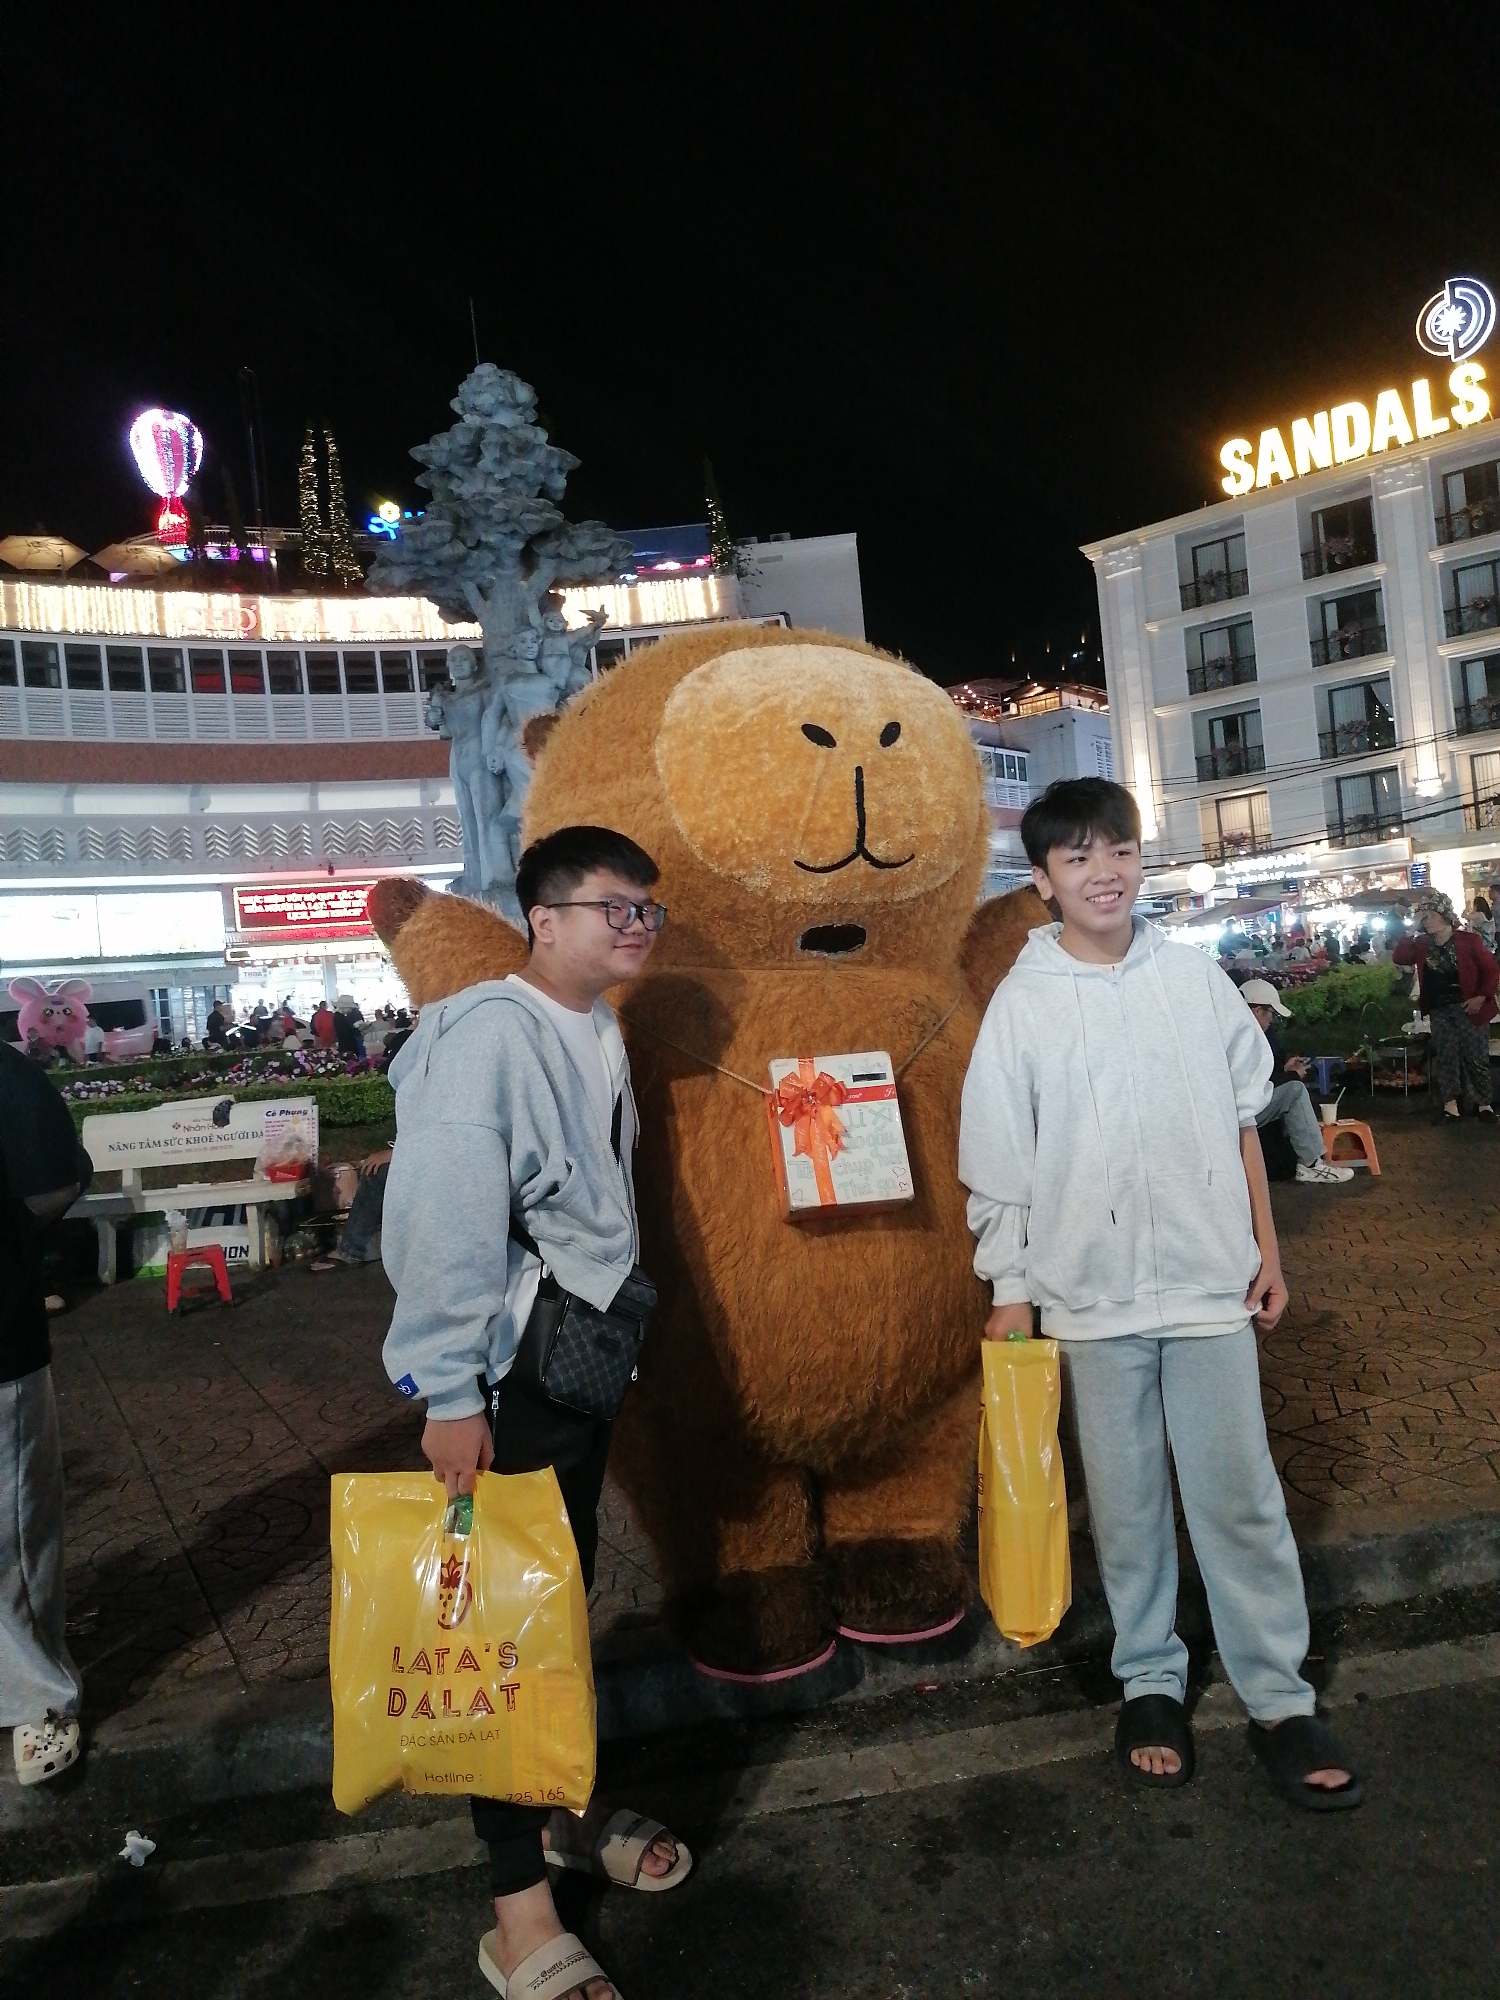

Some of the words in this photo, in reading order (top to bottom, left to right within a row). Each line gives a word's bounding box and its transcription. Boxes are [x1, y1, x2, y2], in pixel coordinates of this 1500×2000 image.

[1219, 362, 1490, 496] SANDALS
[108, 1141, 136, 1152] NÂNG
[163, 1134, 184, 1147] SỨC
[216, 1130, 249, 1143] NGƯỜI
[391, 1641, 518, 1676] LATA'S
[387, 1683, 520, 1719] DALAT
[400, 1734, 427, 1749] ĐẶC
[430, 1731, 455, 1746] SẢN
[458, 1729, 476, 1743] ĐÀ
[480, 1728, 501, 1743] LẠT
[424, 1772, 475, 1783] Hotline
[540, 1787, 565, 1801] 165
